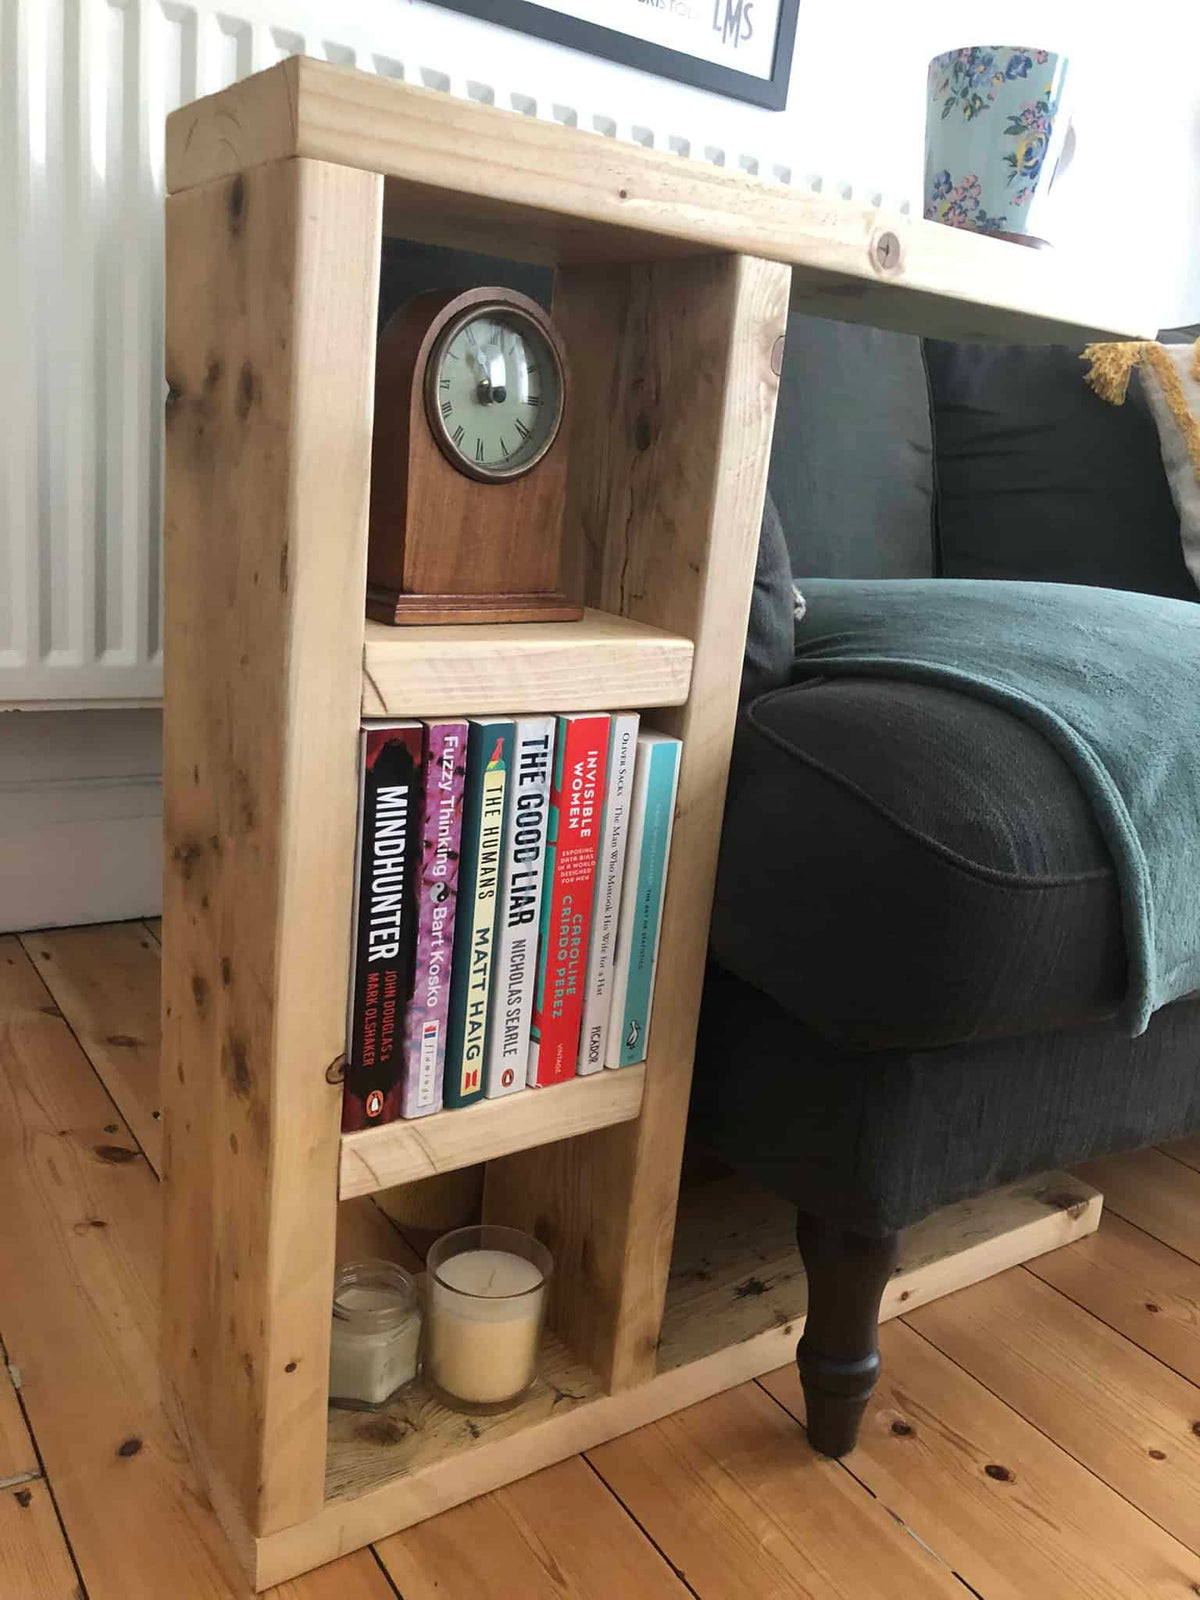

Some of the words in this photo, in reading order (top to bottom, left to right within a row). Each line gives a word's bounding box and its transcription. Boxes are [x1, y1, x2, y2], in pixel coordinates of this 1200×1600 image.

[713, 0, 753, 48] LMS
[439, 736, 458, 790] Fuzzy
[519, 735, 549, 786] THE
[484, 785, 503, 817] THE
[568, 762, 584, 828] WOMEN
[580, 751, 598, 837] INVISIBLE
[613, 806, 623, 823] The
[432, 796, 455, 876] Thinking
[514, 794, 544, 863] GOOD
[611, 827, 620, 847] Man
[368, 785, 409, 962] MINDHUNTER
[478, 827, 499, 900] HUMANS
[560, 855, 577, 864] DATA
[579, 853, 594, 861] BIAS
[560, 868, 592, 878] DESIGNED
[573, 860, 596, 868] WORLD
[608, 850, 618, 872] Who
[508, 871, 538, 928] LIAR
[604, 875, 616, 912] Mistook
[431, 907, 447, 946] Bart
[558, 896, 572, 960] CRIADO
[600, 933, 610, 953] Wife
[602, 916, 612, 931] His
[426, 951, 444, 1007] Kosko
[472, 928, 490, 990] MATT
[507, 940, 526, 1005] NICHOLAS
[567, 914, 582, 995] CAROLINE
[599, 956, 607, 968] for
[366, 972, 378, 1006] MARK
[384, 970, 397, 997] JOHN
[552, 968, 565, 1019] PEREZ
[596, 979, 605, 996] Hat
[362, 1009, 377, 1066] OLSHAKER
[381, 1000, 394, 1052] DOUGLAS
[466, 1001, 484, 1061] HAIG
[503, 1008, 521, 1057] SEARLE
[588, 1026, 602, 1064] PICADOR
[554, 1043, 564, 1074] VINTAGE
